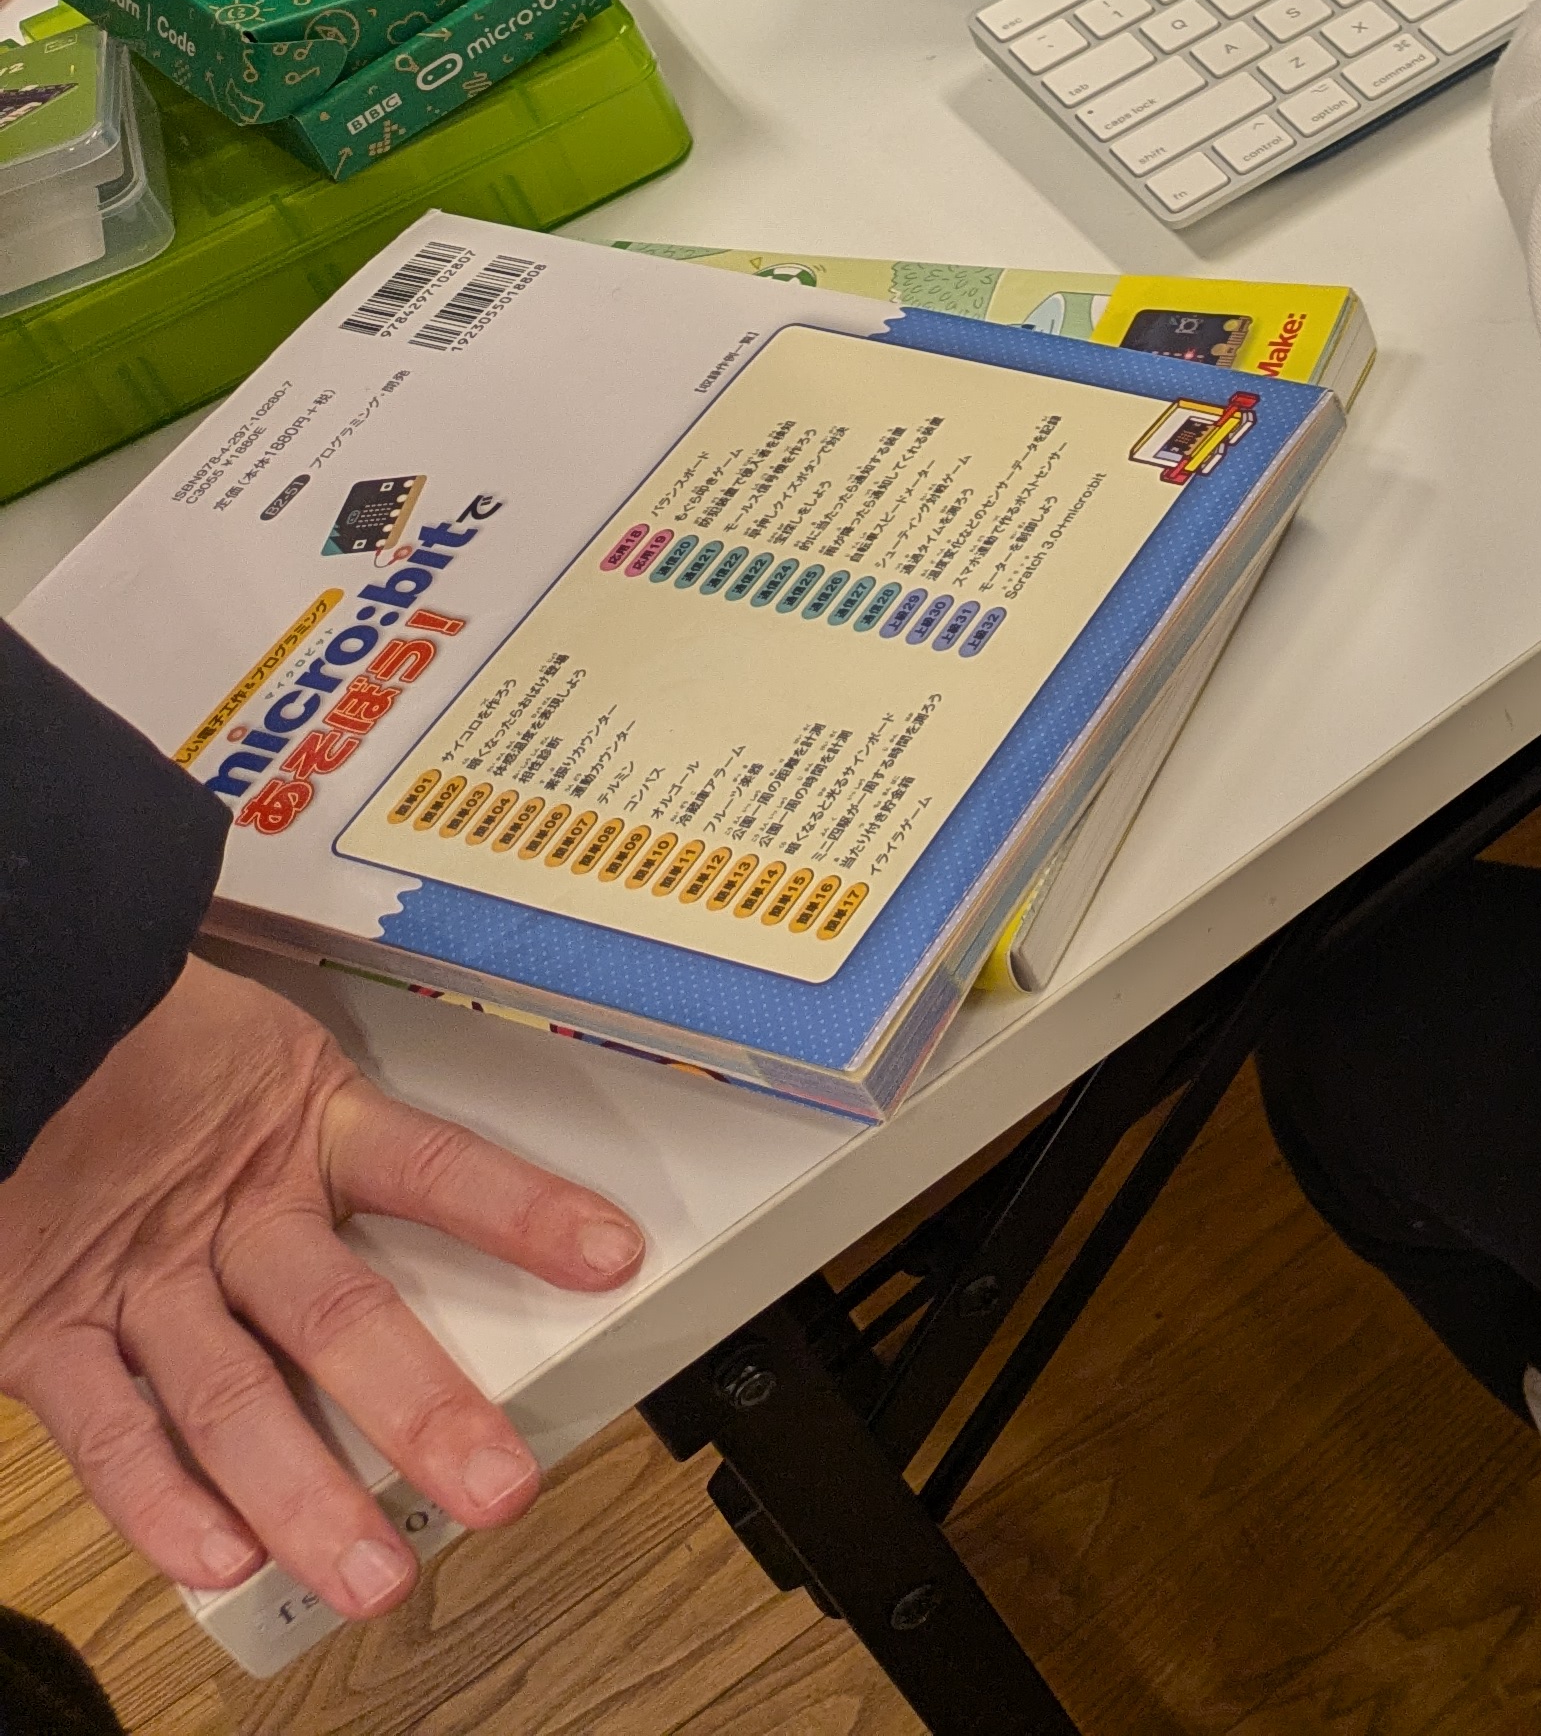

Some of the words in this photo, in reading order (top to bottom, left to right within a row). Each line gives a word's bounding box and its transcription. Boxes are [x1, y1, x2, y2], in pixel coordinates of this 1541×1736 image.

[157, 16, 196, 56] Code
[1002, 17, 1023, 30] esc
[1372, 53, 1427, 88] command
[1068, 82, 1090, 97] tab
[347, 93, 402, 134] BBC
[1103, 112, 1132, 131] caps
[1131, 98, 1157, 114] lock
[1311, 98, 1349, 124] option
[1137, 146, 1168, 165] shift
[1241, 135, 1285, 163] control
[1173, 189, 1189, 200] fn
[378, 249, 479, 338] 9784297102807
[448, 262, 548, 352] 1923055018808
[170, 380, 296, 502] ISBN978-4-297-10280-7
[182, 468, 227, 504] C3055
[219, 425, 269, 467] ¥1880E
[1003, 550, 1048, 599] Scratch
[1039, 471, 1107, 549] 3.0+micro:bit
[175, 599, 334, 764] しい電子工作&プログラミング
